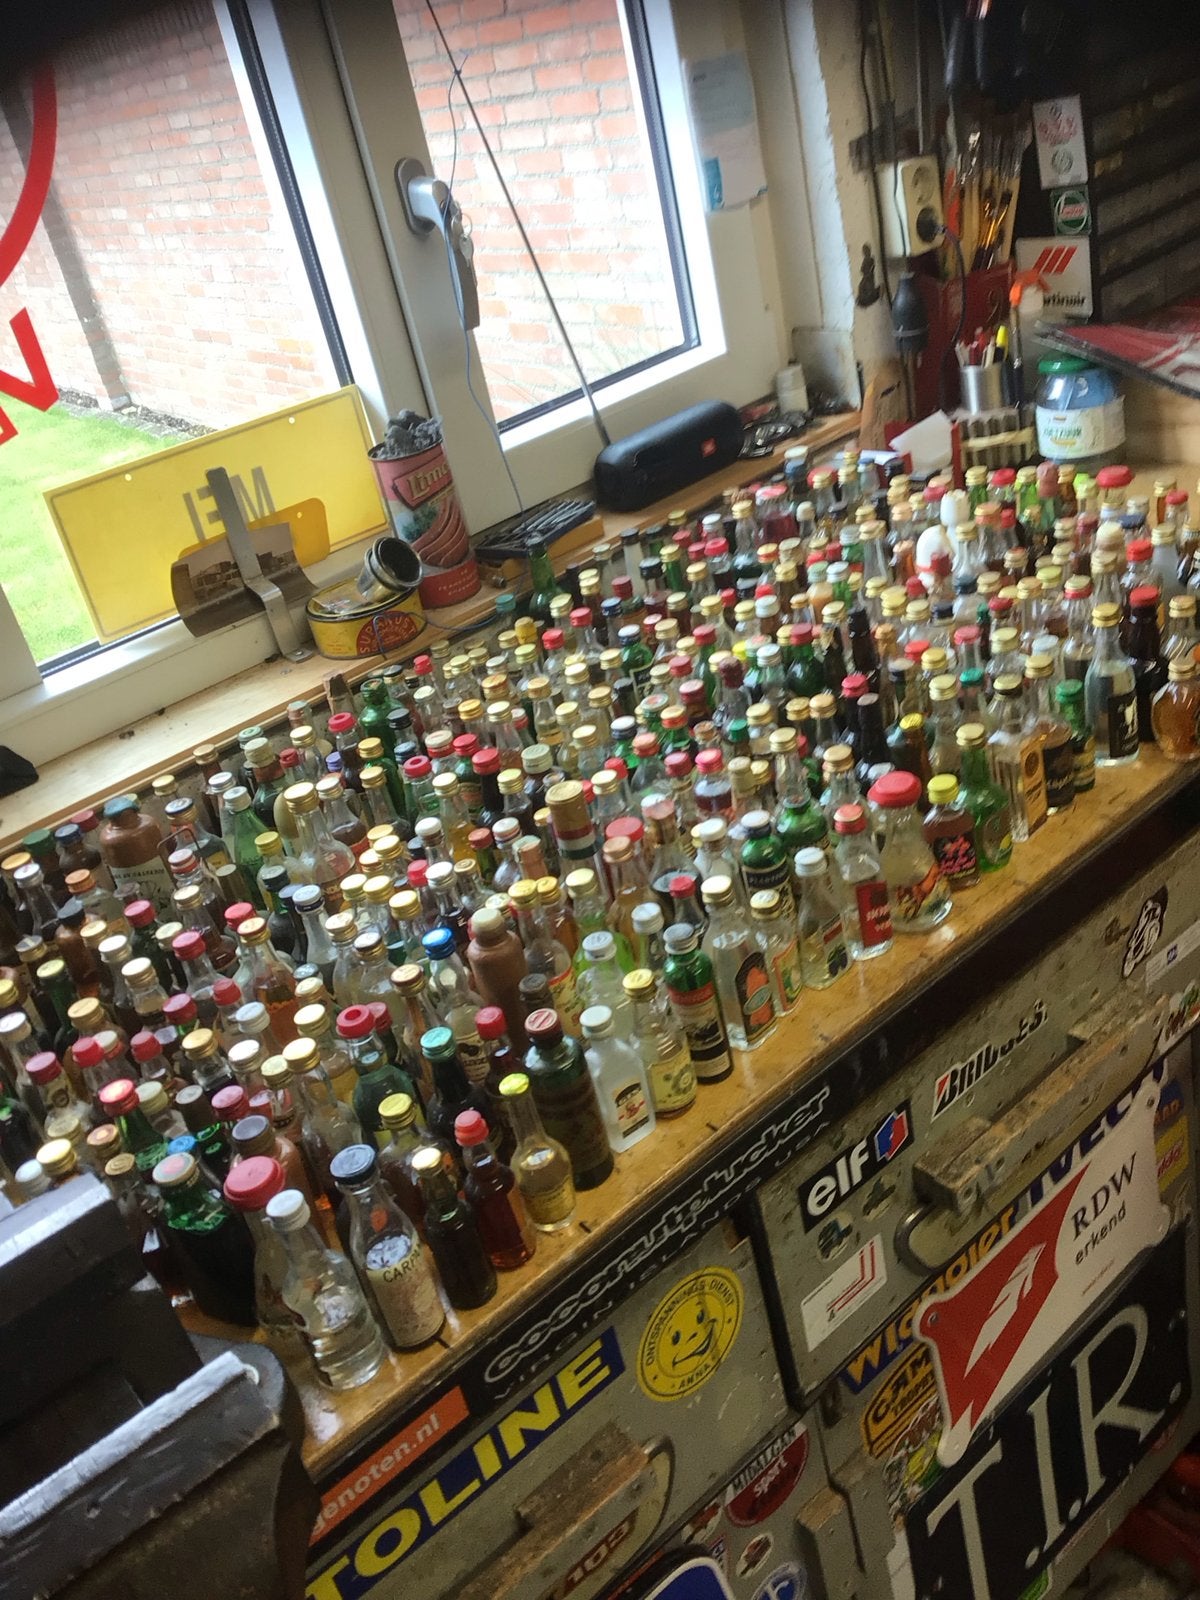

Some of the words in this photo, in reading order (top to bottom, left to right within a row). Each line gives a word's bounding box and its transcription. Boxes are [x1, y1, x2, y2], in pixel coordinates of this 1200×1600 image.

[807, 1140, 869, 1216] elf
[1071, 1152, 1137, 1241] RDW
[495, 1299, 613, 1399] VIRGIN
[629, 1176, 763, 1291] ISLANDS
[774, 1121, 831, 1168] USA
[1075, 1200, 1126, 1265] erkend
[709, 1279, 734, 1309] DIENST
[872, 1350, 931, 1425] CAM
